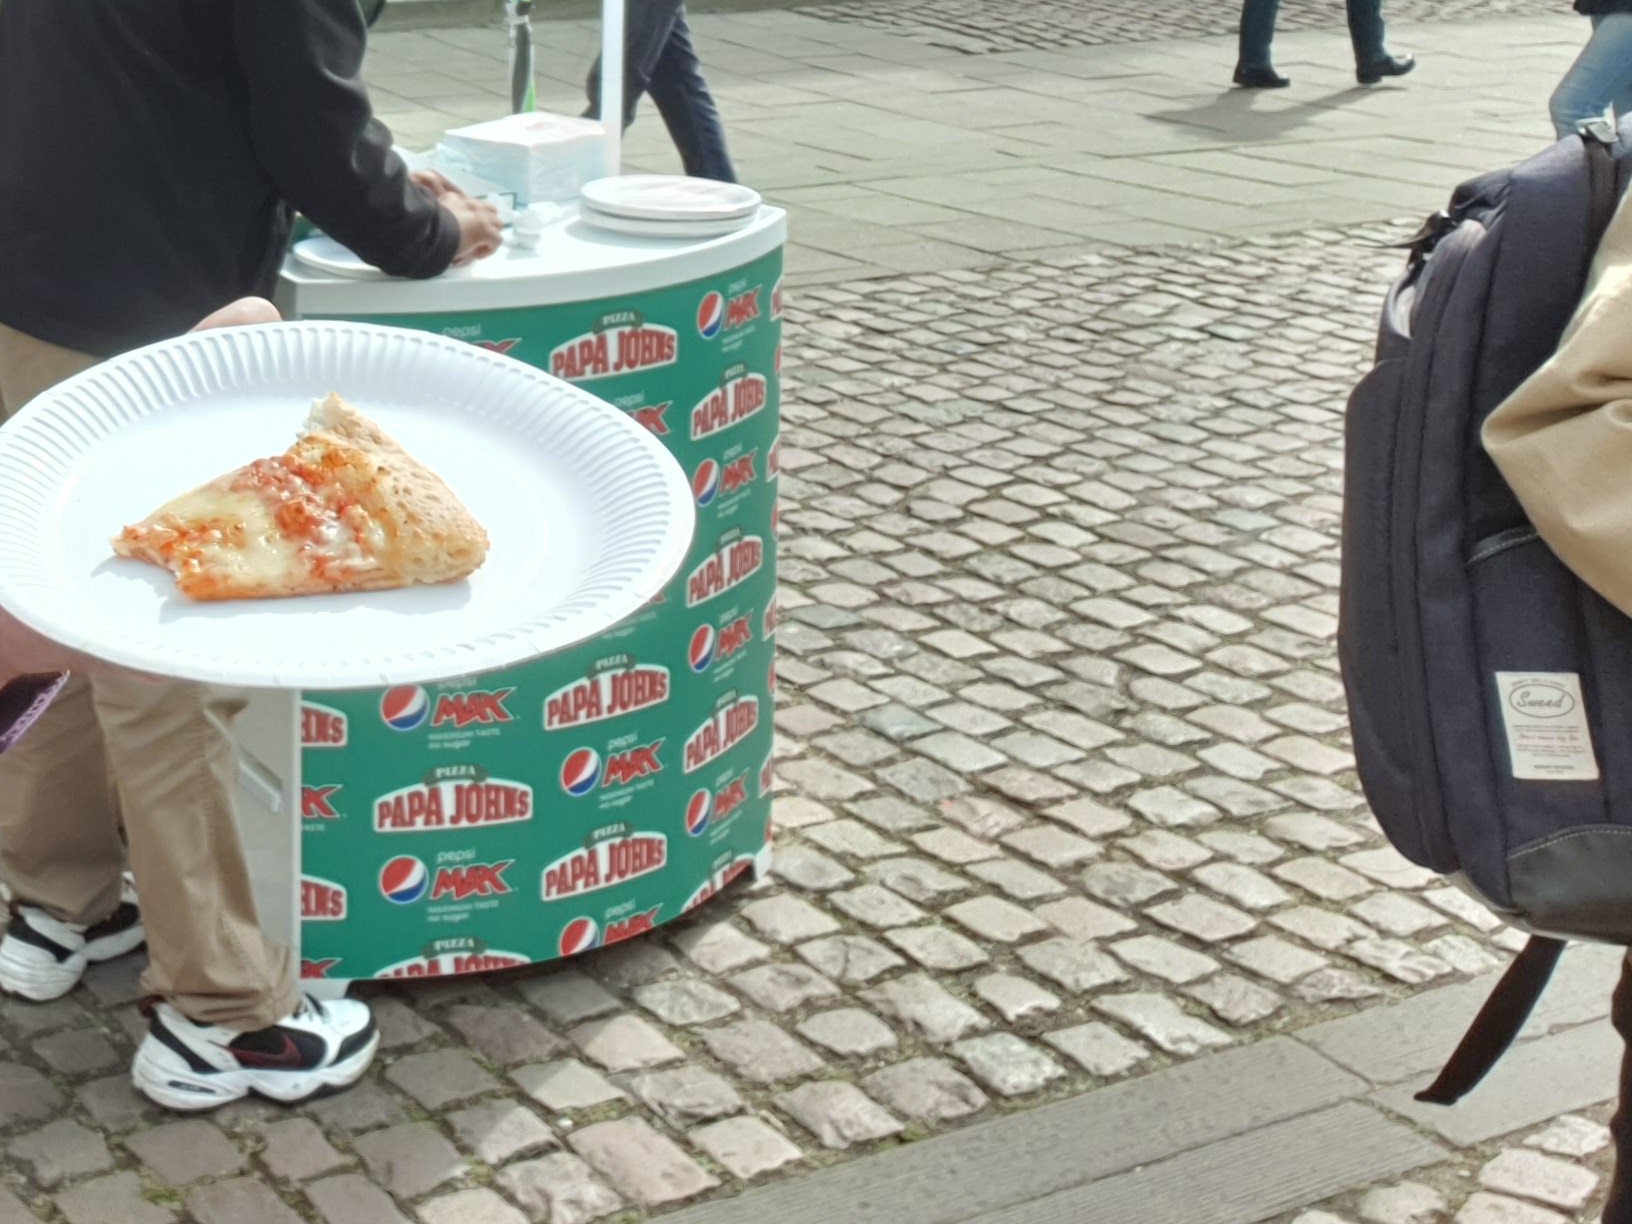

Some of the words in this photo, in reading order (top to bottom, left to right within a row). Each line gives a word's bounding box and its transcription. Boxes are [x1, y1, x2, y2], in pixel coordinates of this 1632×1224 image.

[552, 333, 610, 378] PAPA
[430, 686, 517, 728] MAX
[547, 677, 603, 727] PAPA
[435, 765, 477, 778] PIZZA
[600, 736, 667, 788] MAX
[378, 787, 445, 830] PAPA
[428, 858, 516, 901] MAX
[545, 847, 601, 897] PAPA
[434, 937, 475, 951] PIZZA
